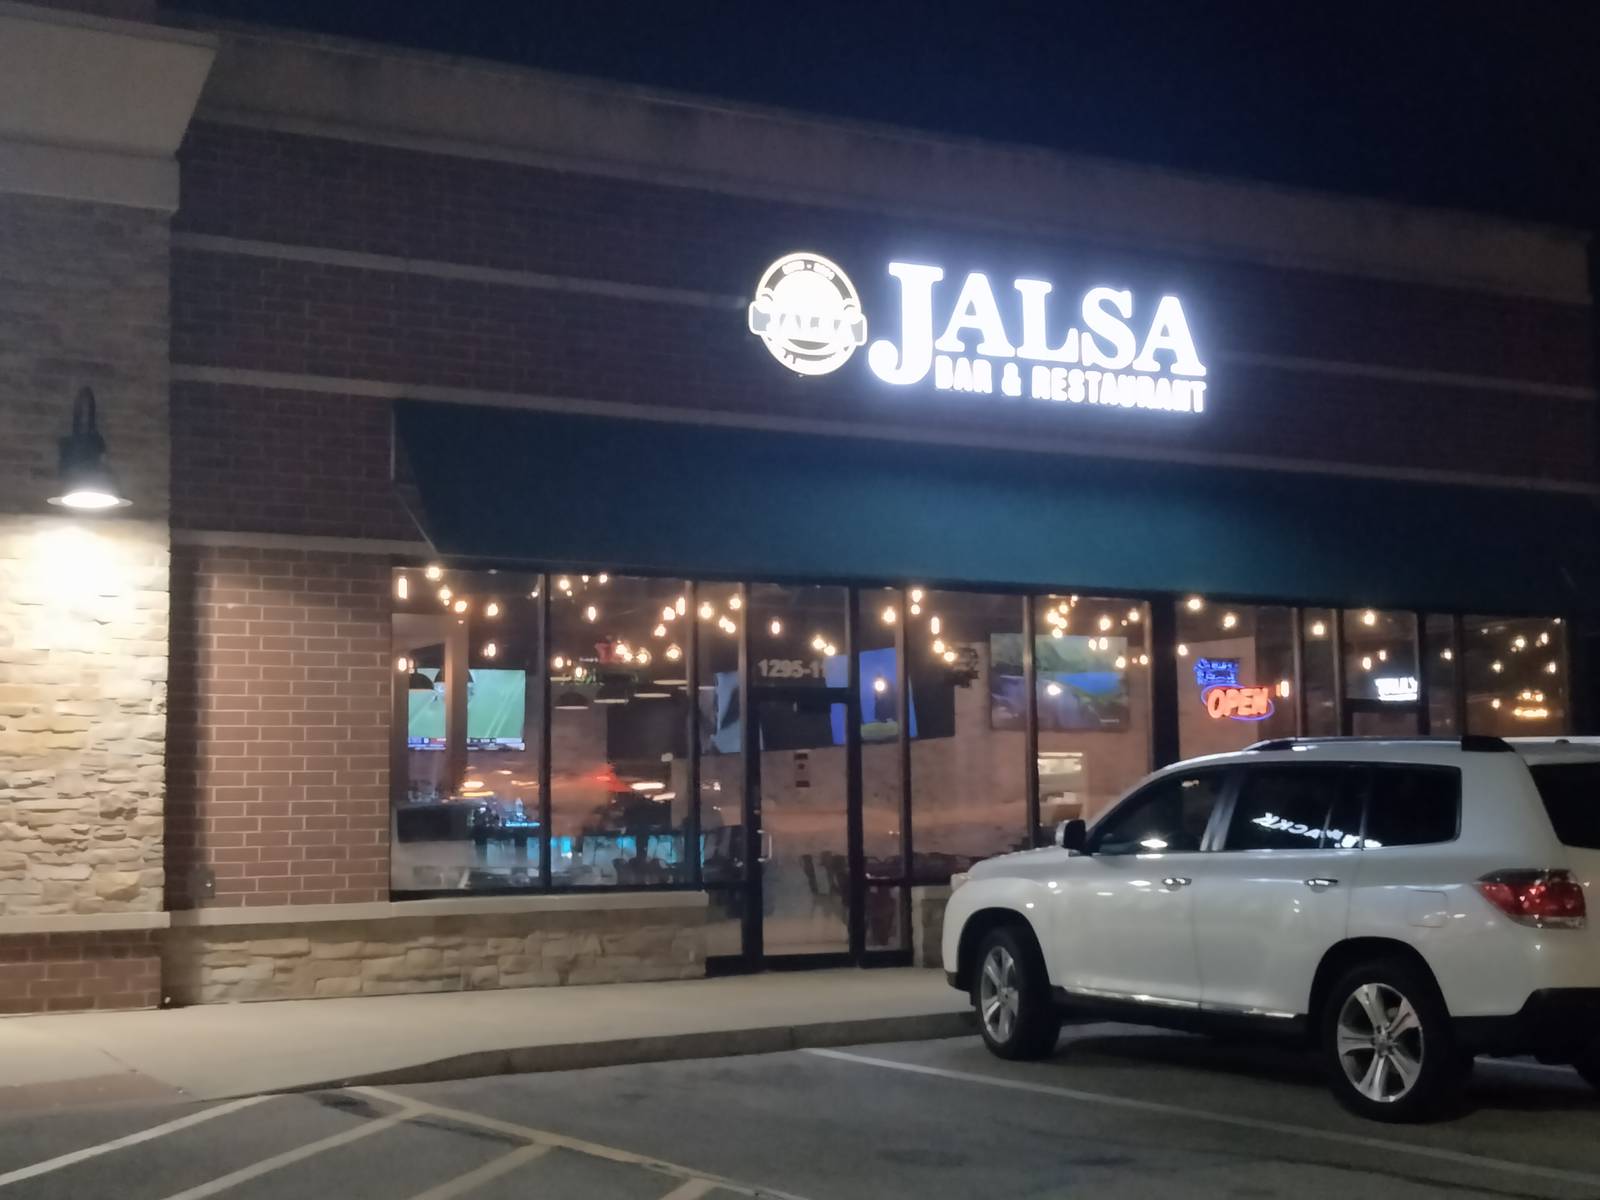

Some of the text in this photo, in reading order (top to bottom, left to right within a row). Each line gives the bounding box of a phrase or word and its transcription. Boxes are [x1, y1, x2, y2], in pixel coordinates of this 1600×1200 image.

[868, 262, 1206, 385] JALSA
[935, 355, 1207, 413] BAR & RESTAURANT
[1207, 687, 1268, 718] OPEN
